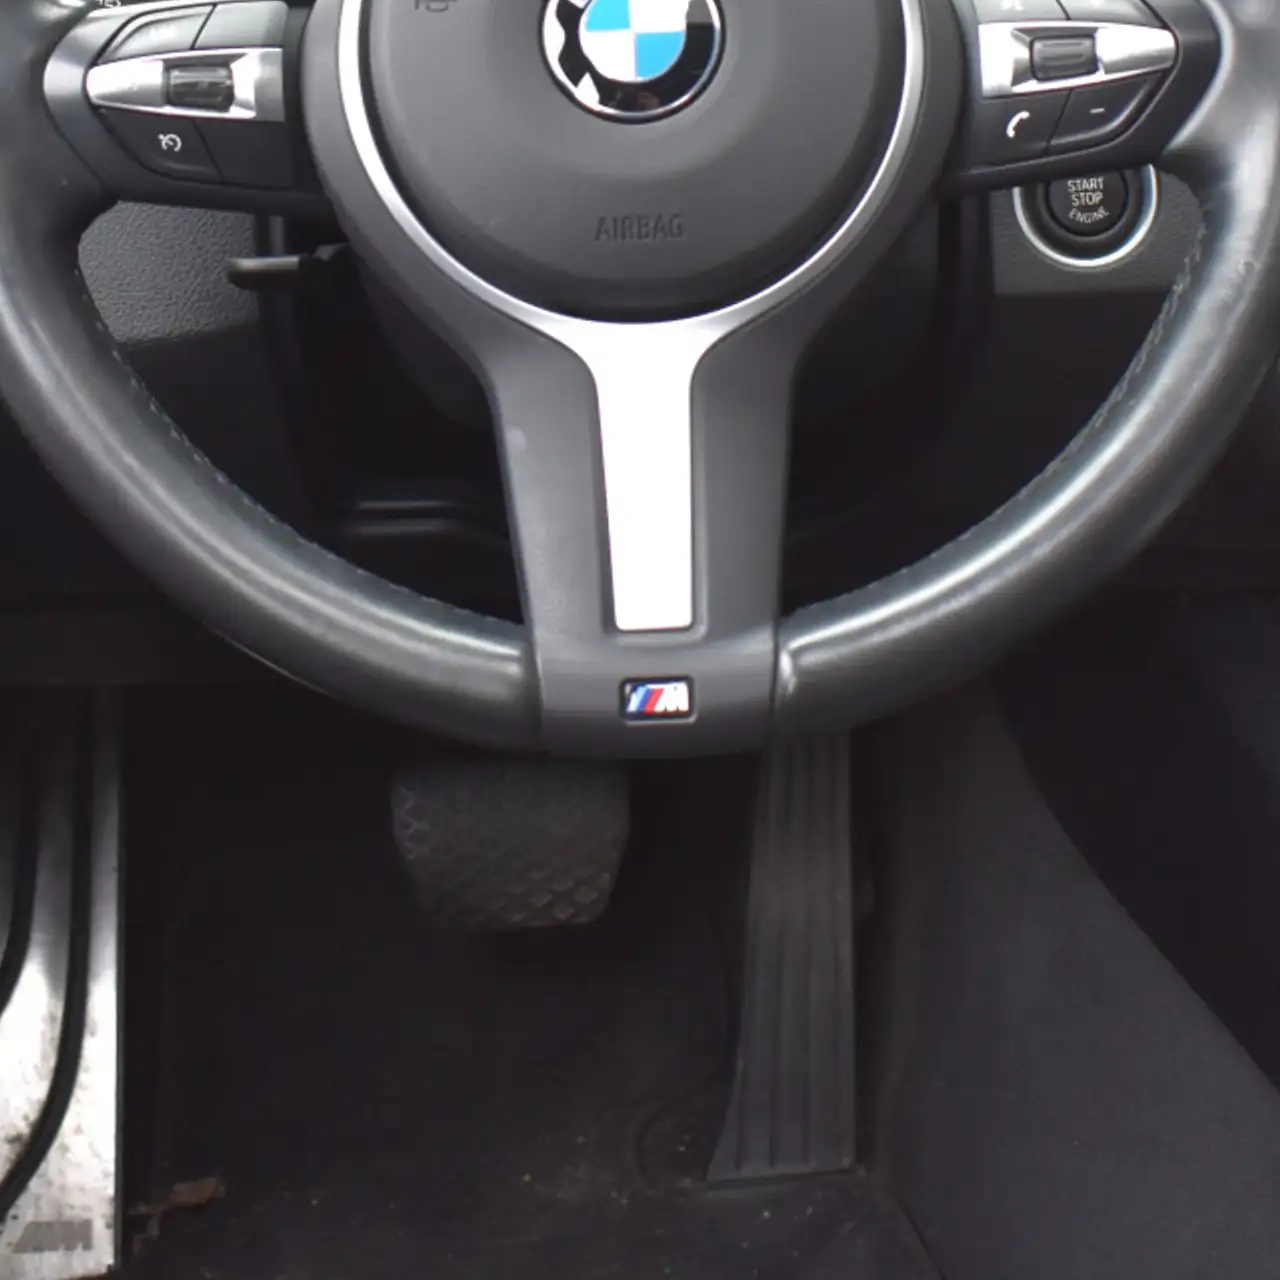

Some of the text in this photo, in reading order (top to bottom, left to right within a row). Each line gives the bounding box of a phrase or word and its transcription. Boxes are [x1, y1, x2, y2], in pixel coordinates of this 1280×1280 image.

[1067, 177, 1104, 192] START
[1071, 193, 1103, 206] STOP
[1069, 206, 1109, 224] ENGINE
[594, 214, 685, 241] AIRBAG
